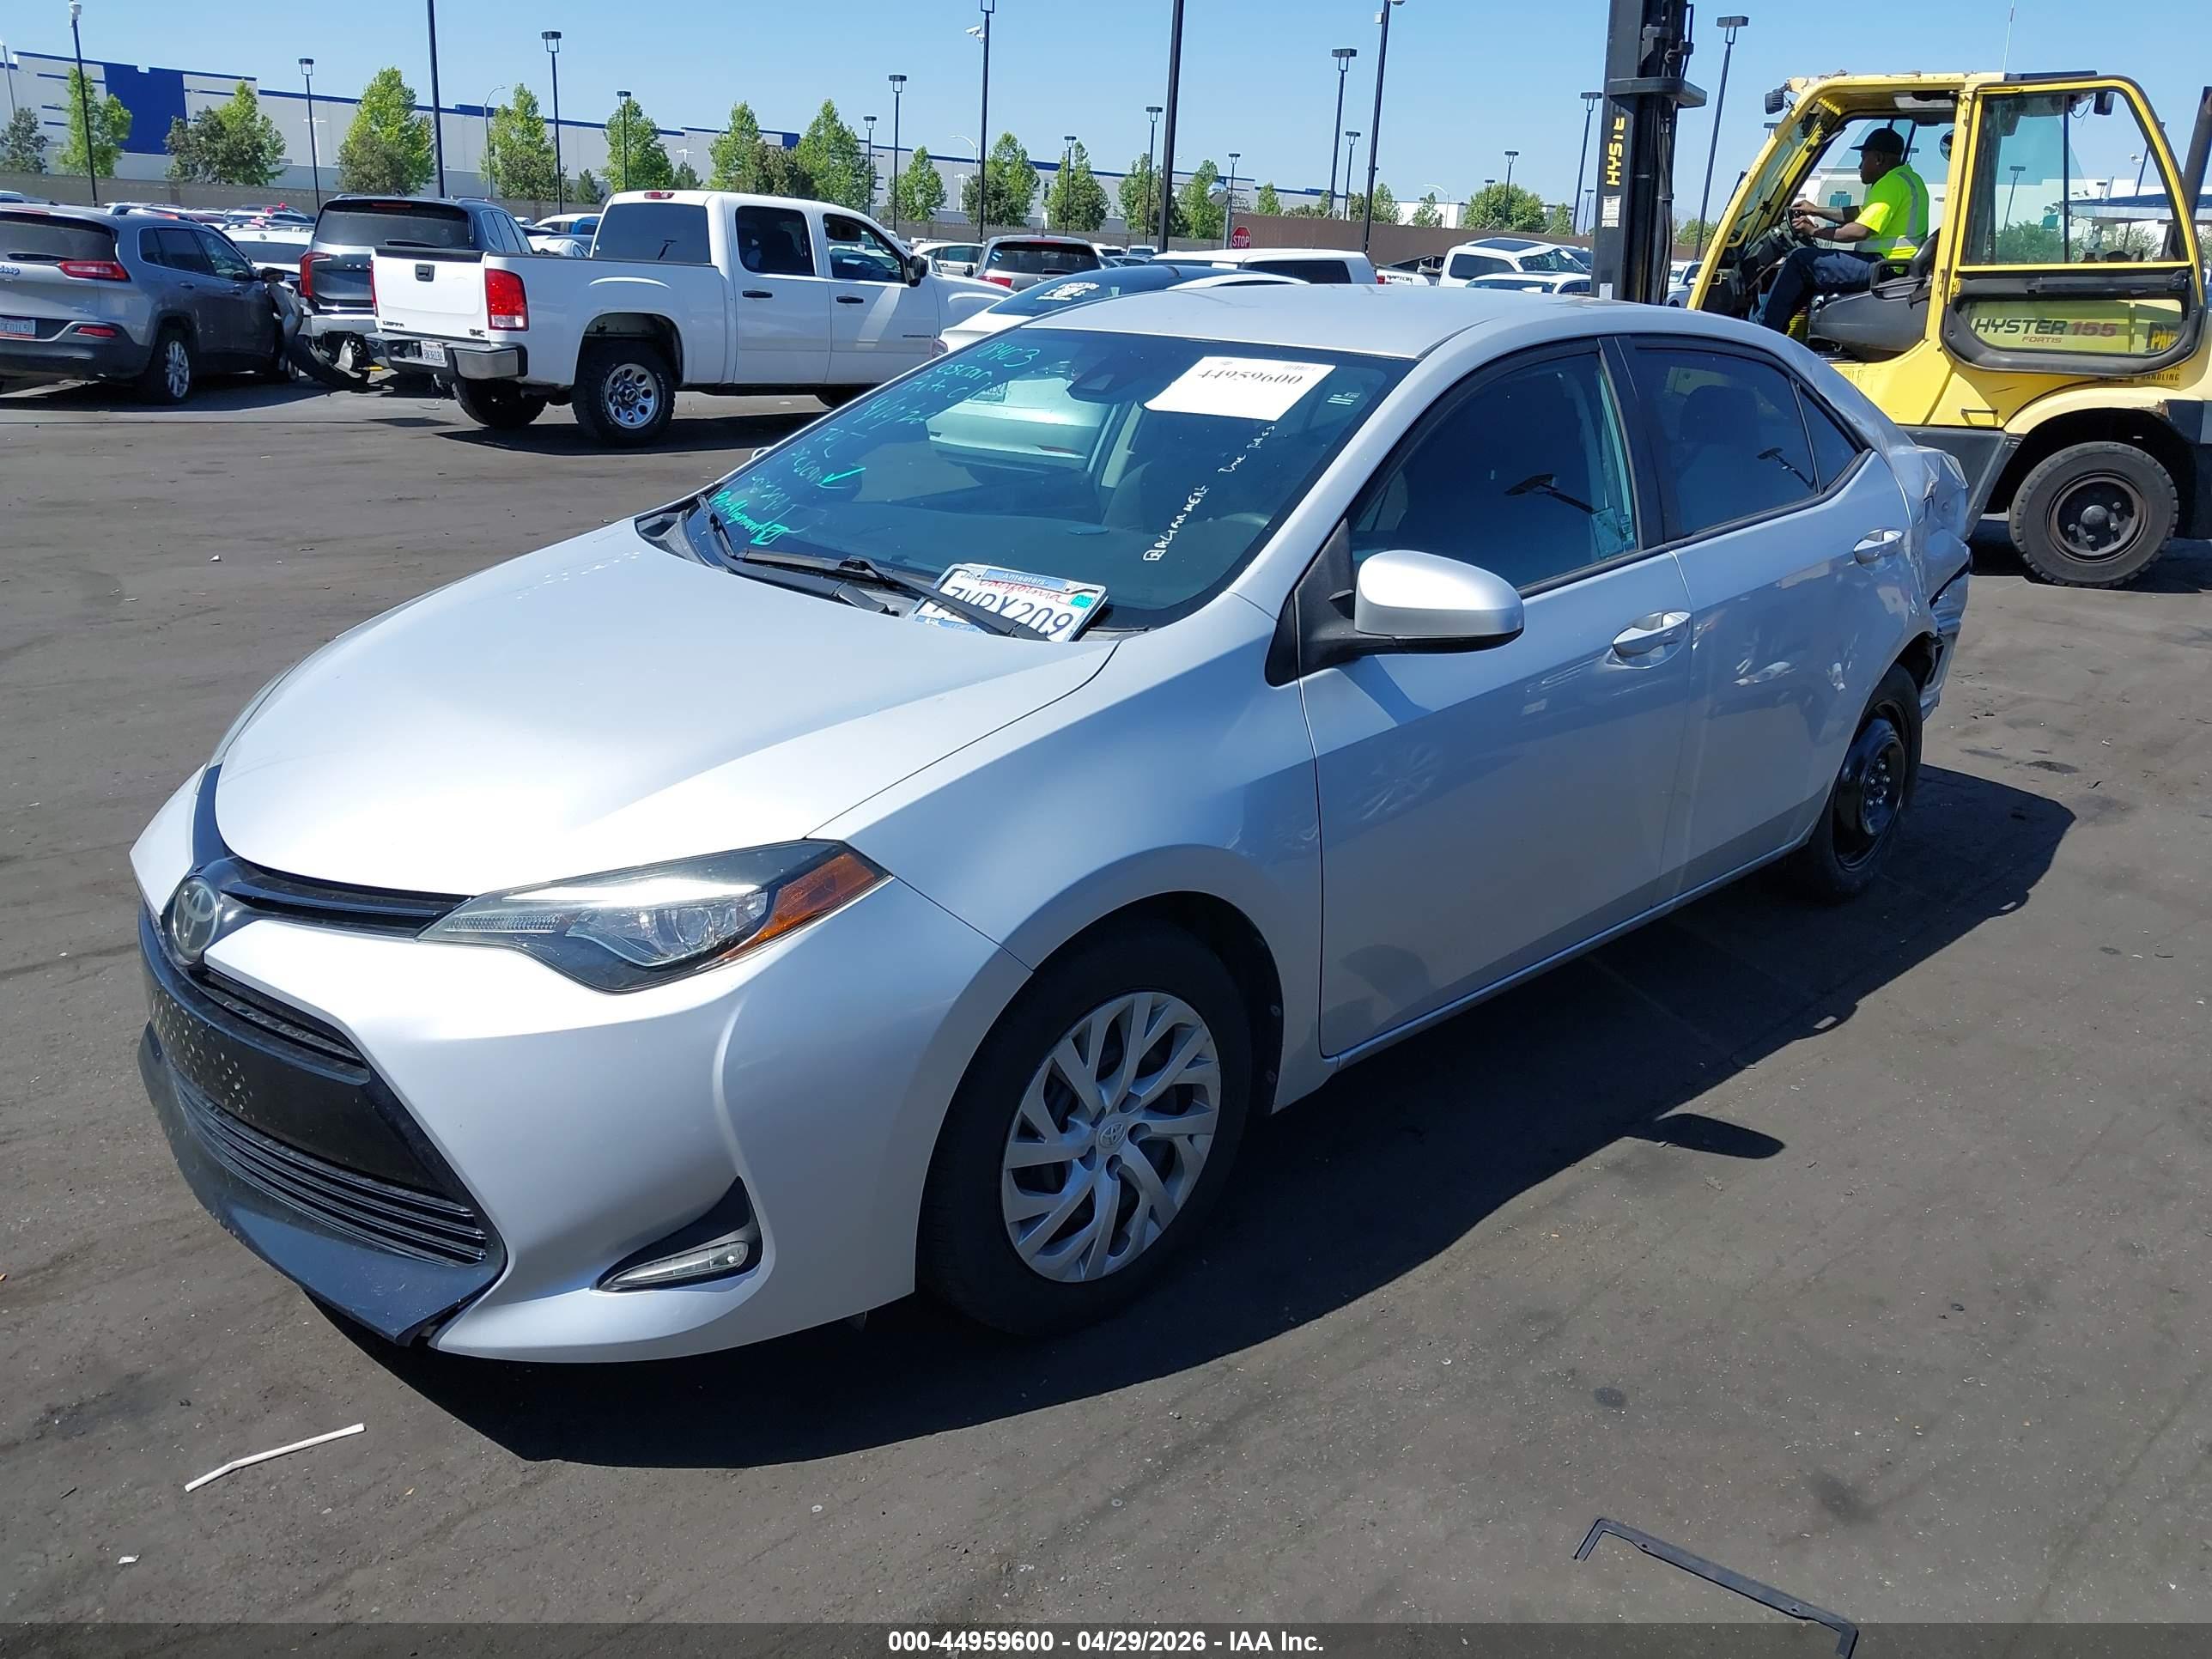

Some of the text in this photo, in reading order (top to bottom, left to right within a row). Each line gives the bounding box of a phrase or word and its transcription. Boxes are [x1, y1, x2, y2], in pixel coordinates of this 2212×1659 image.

[1232, 234, 1249, 247] STOP
[1974, 318, 2118, 337] HYSTER 155
